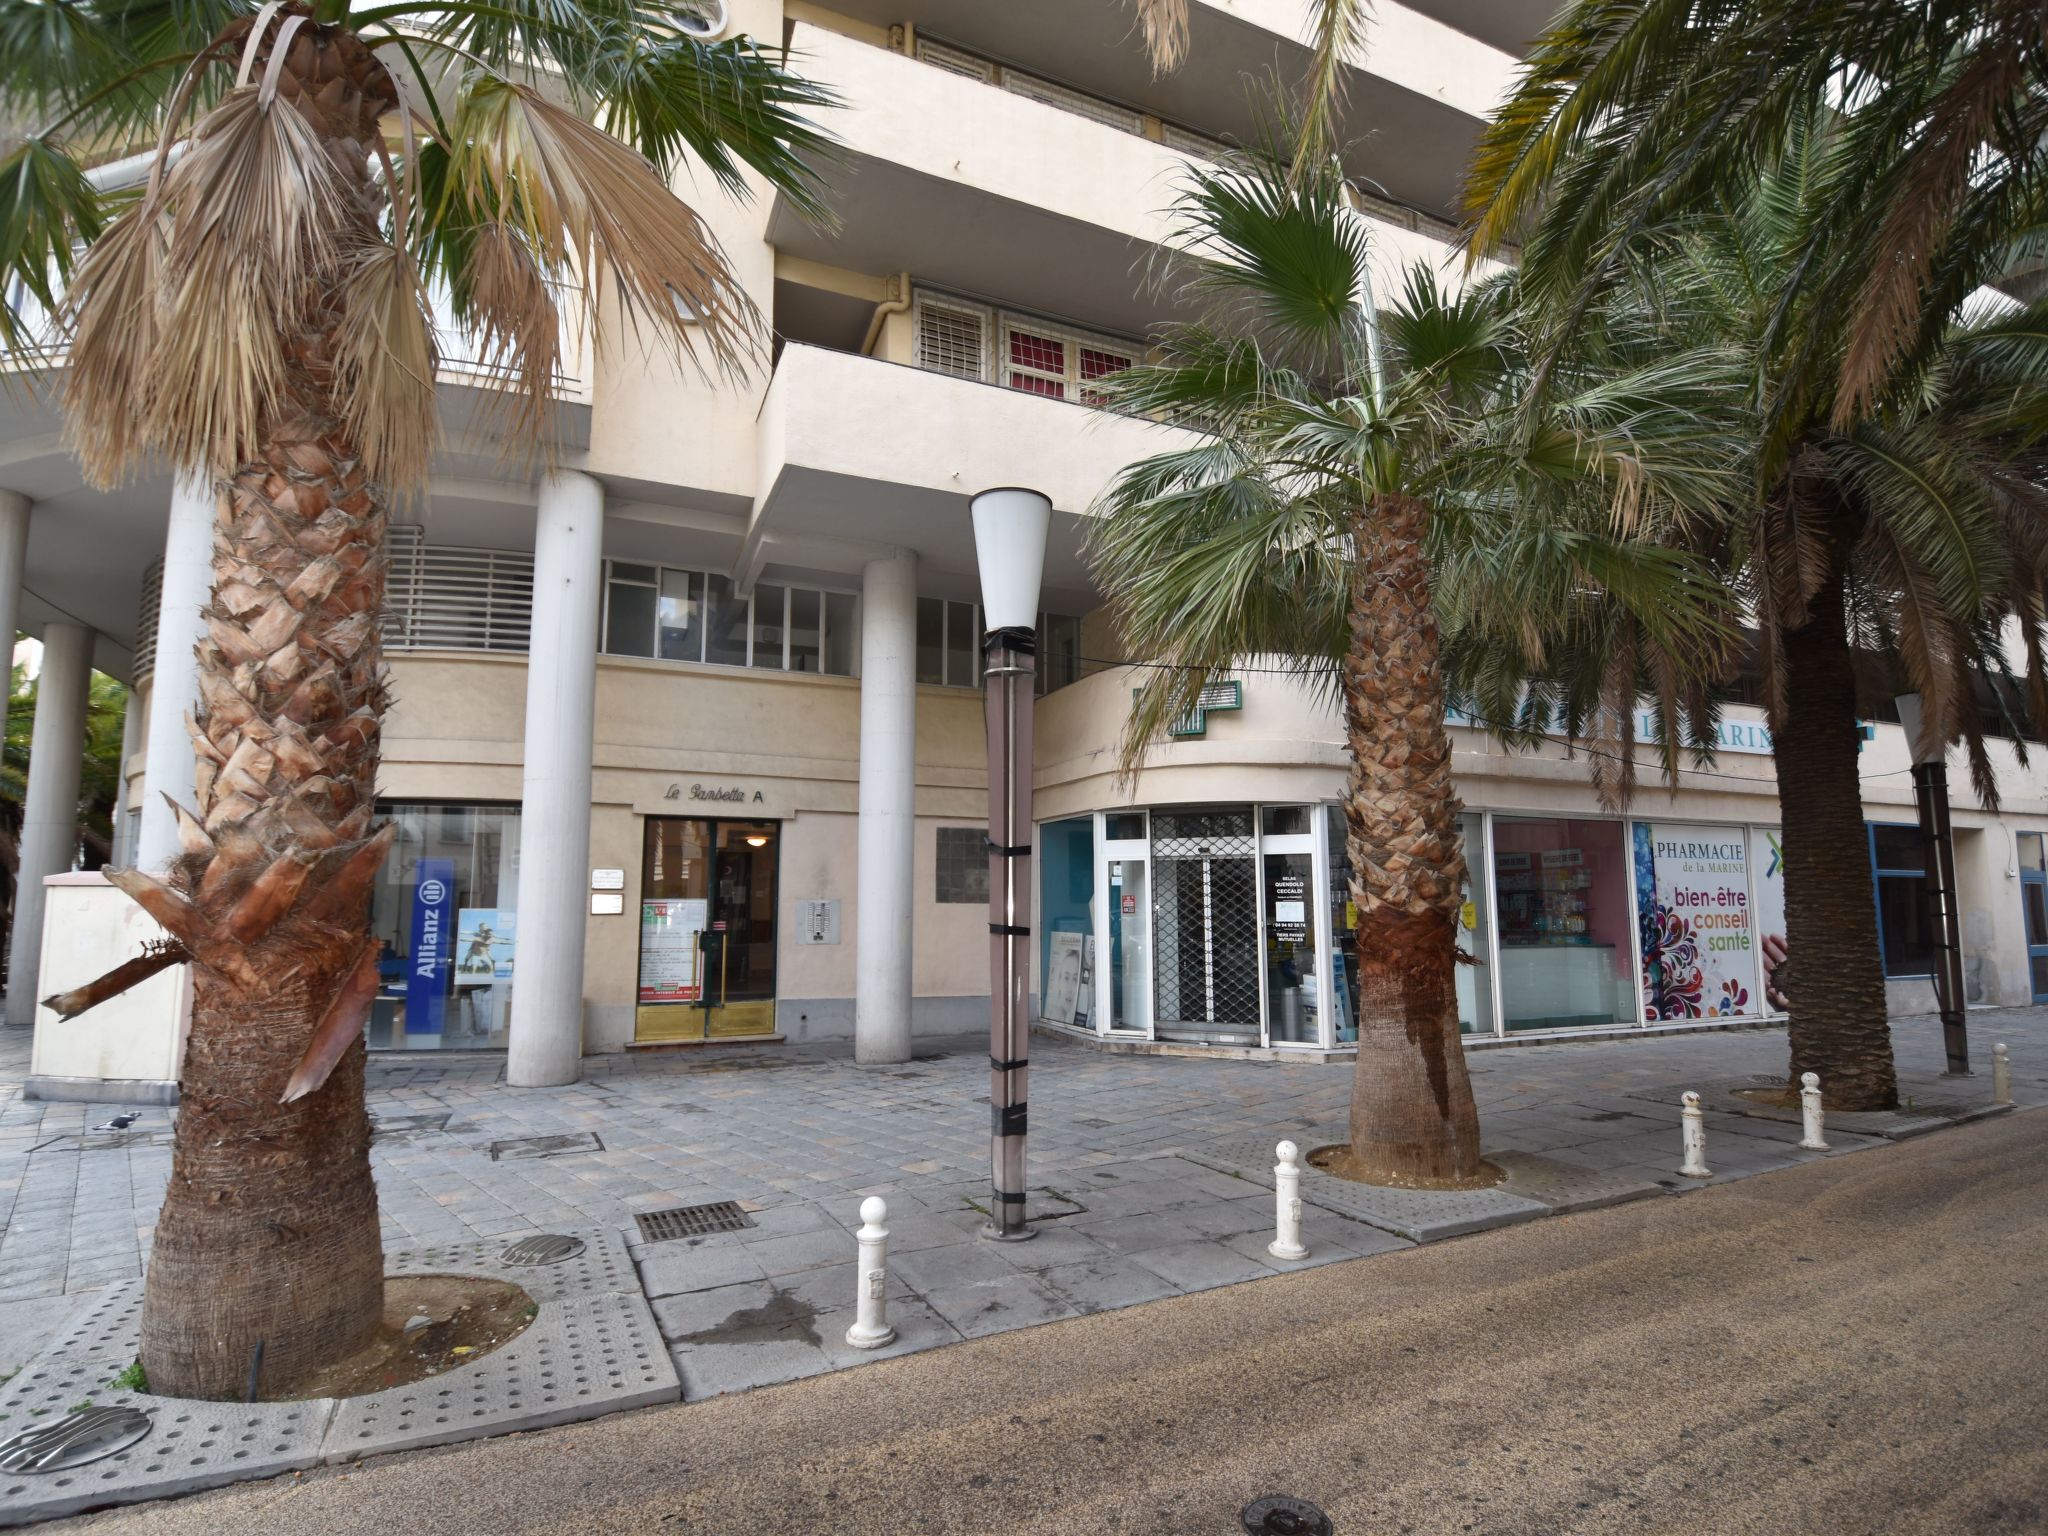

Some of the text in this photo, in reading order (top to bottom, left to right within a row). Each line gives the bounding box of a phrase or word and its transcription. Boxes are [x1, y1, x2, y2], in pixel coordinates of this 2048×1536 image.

[664, 784, 680, 800] Le
[752, 790, 764, 803] A
[1656, 841, 1744, 860] PHARMACIE
[1682, 862, 1745, 874] de la MARINE
[1674, 886, 1746, 907] bien-être
[1693, 908, 1749, 929] conseil
[416, 908, 439, 979] Allianz
[1708, 929, 1750, 952] santé
